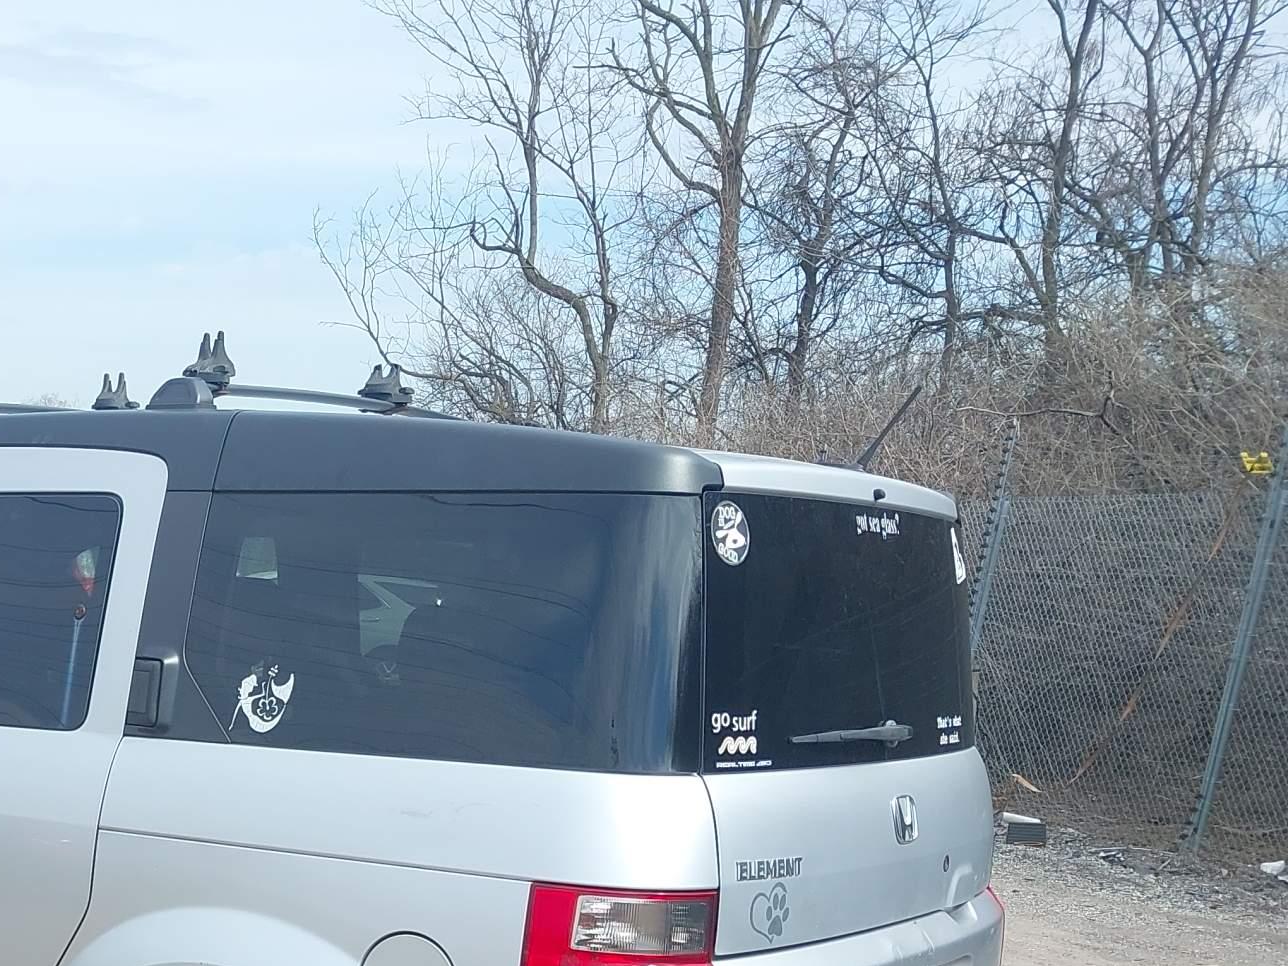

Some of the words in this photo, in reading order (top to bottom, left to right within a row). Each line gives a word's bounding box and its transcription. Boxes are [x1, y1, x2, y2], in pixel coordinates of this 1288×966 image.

[718, 506, 736, 520] DOG
[856, 512, 868, 535] got
[712, 712, 731, 733] go
[732, 709, 758, 732] surf
[736, 857, 803, 881] ELEMENT
